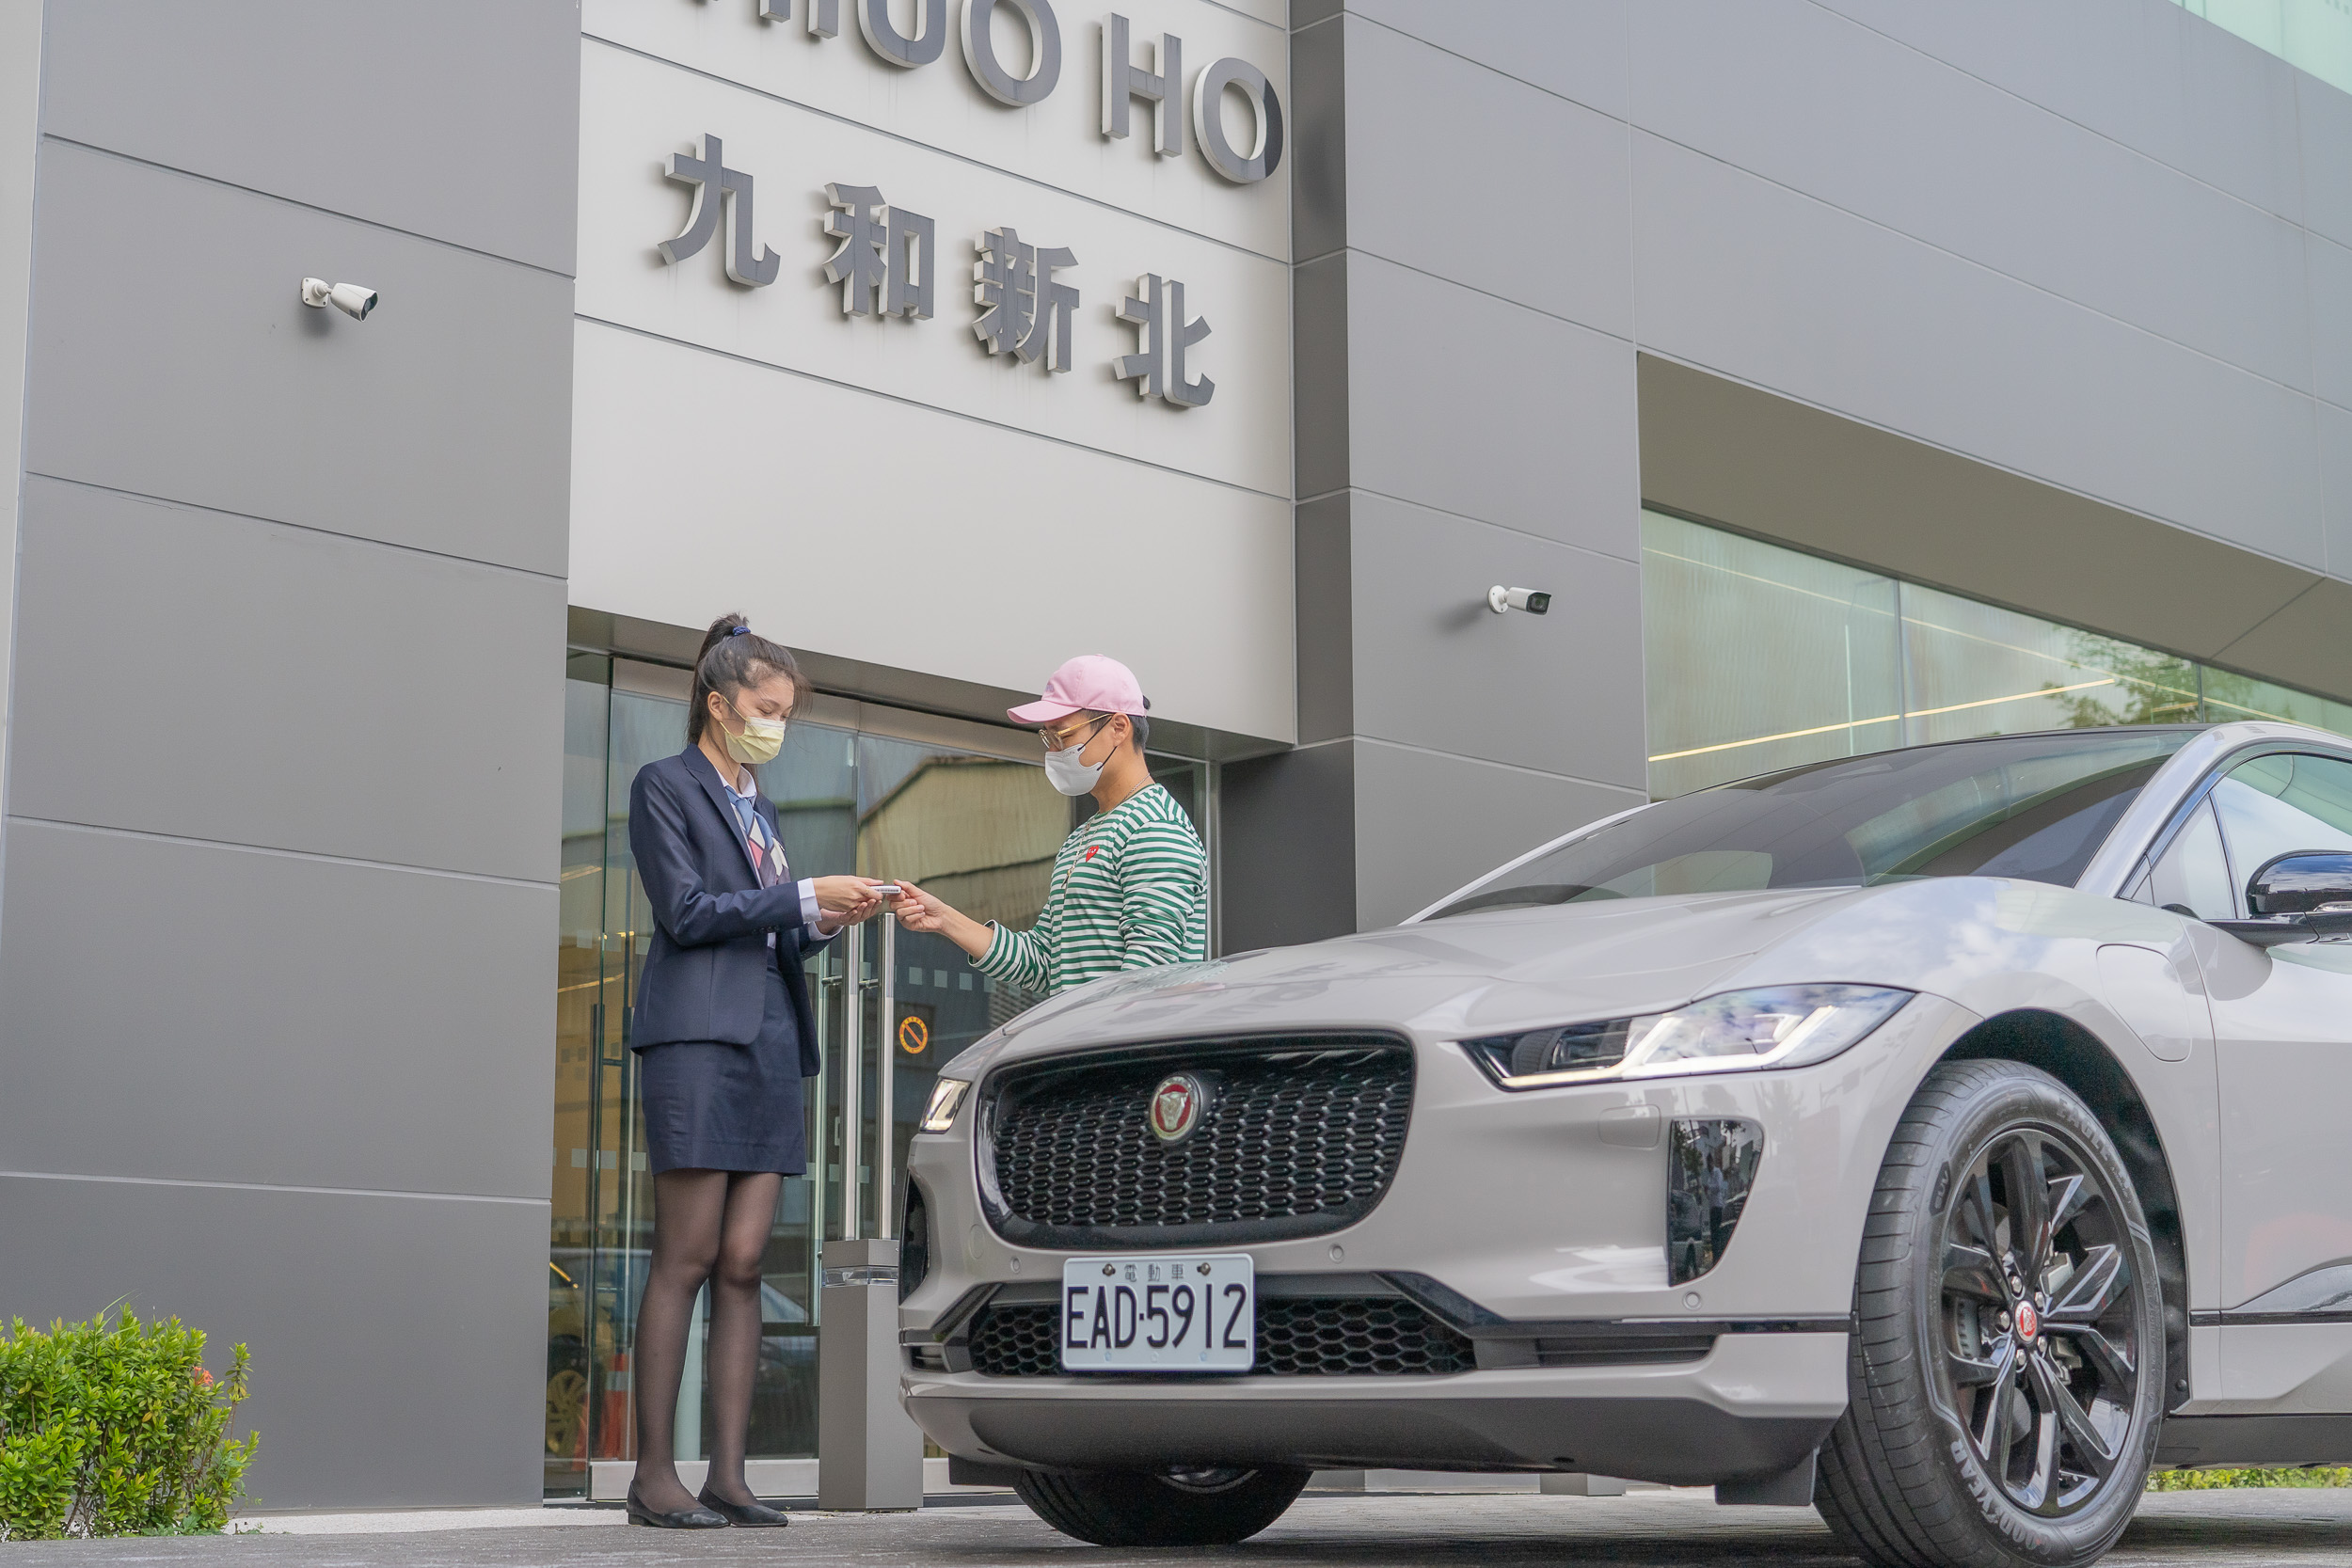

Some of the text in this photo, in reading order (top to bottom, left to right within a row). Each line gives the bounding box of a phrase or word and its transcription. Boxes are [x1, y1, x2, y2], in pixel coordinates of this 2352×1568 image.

[1102, 12, 1284, 184] HO
[658, 133, 1216, 409] 九和新北
[1124, 1263, 1184, 1282] 電動車
